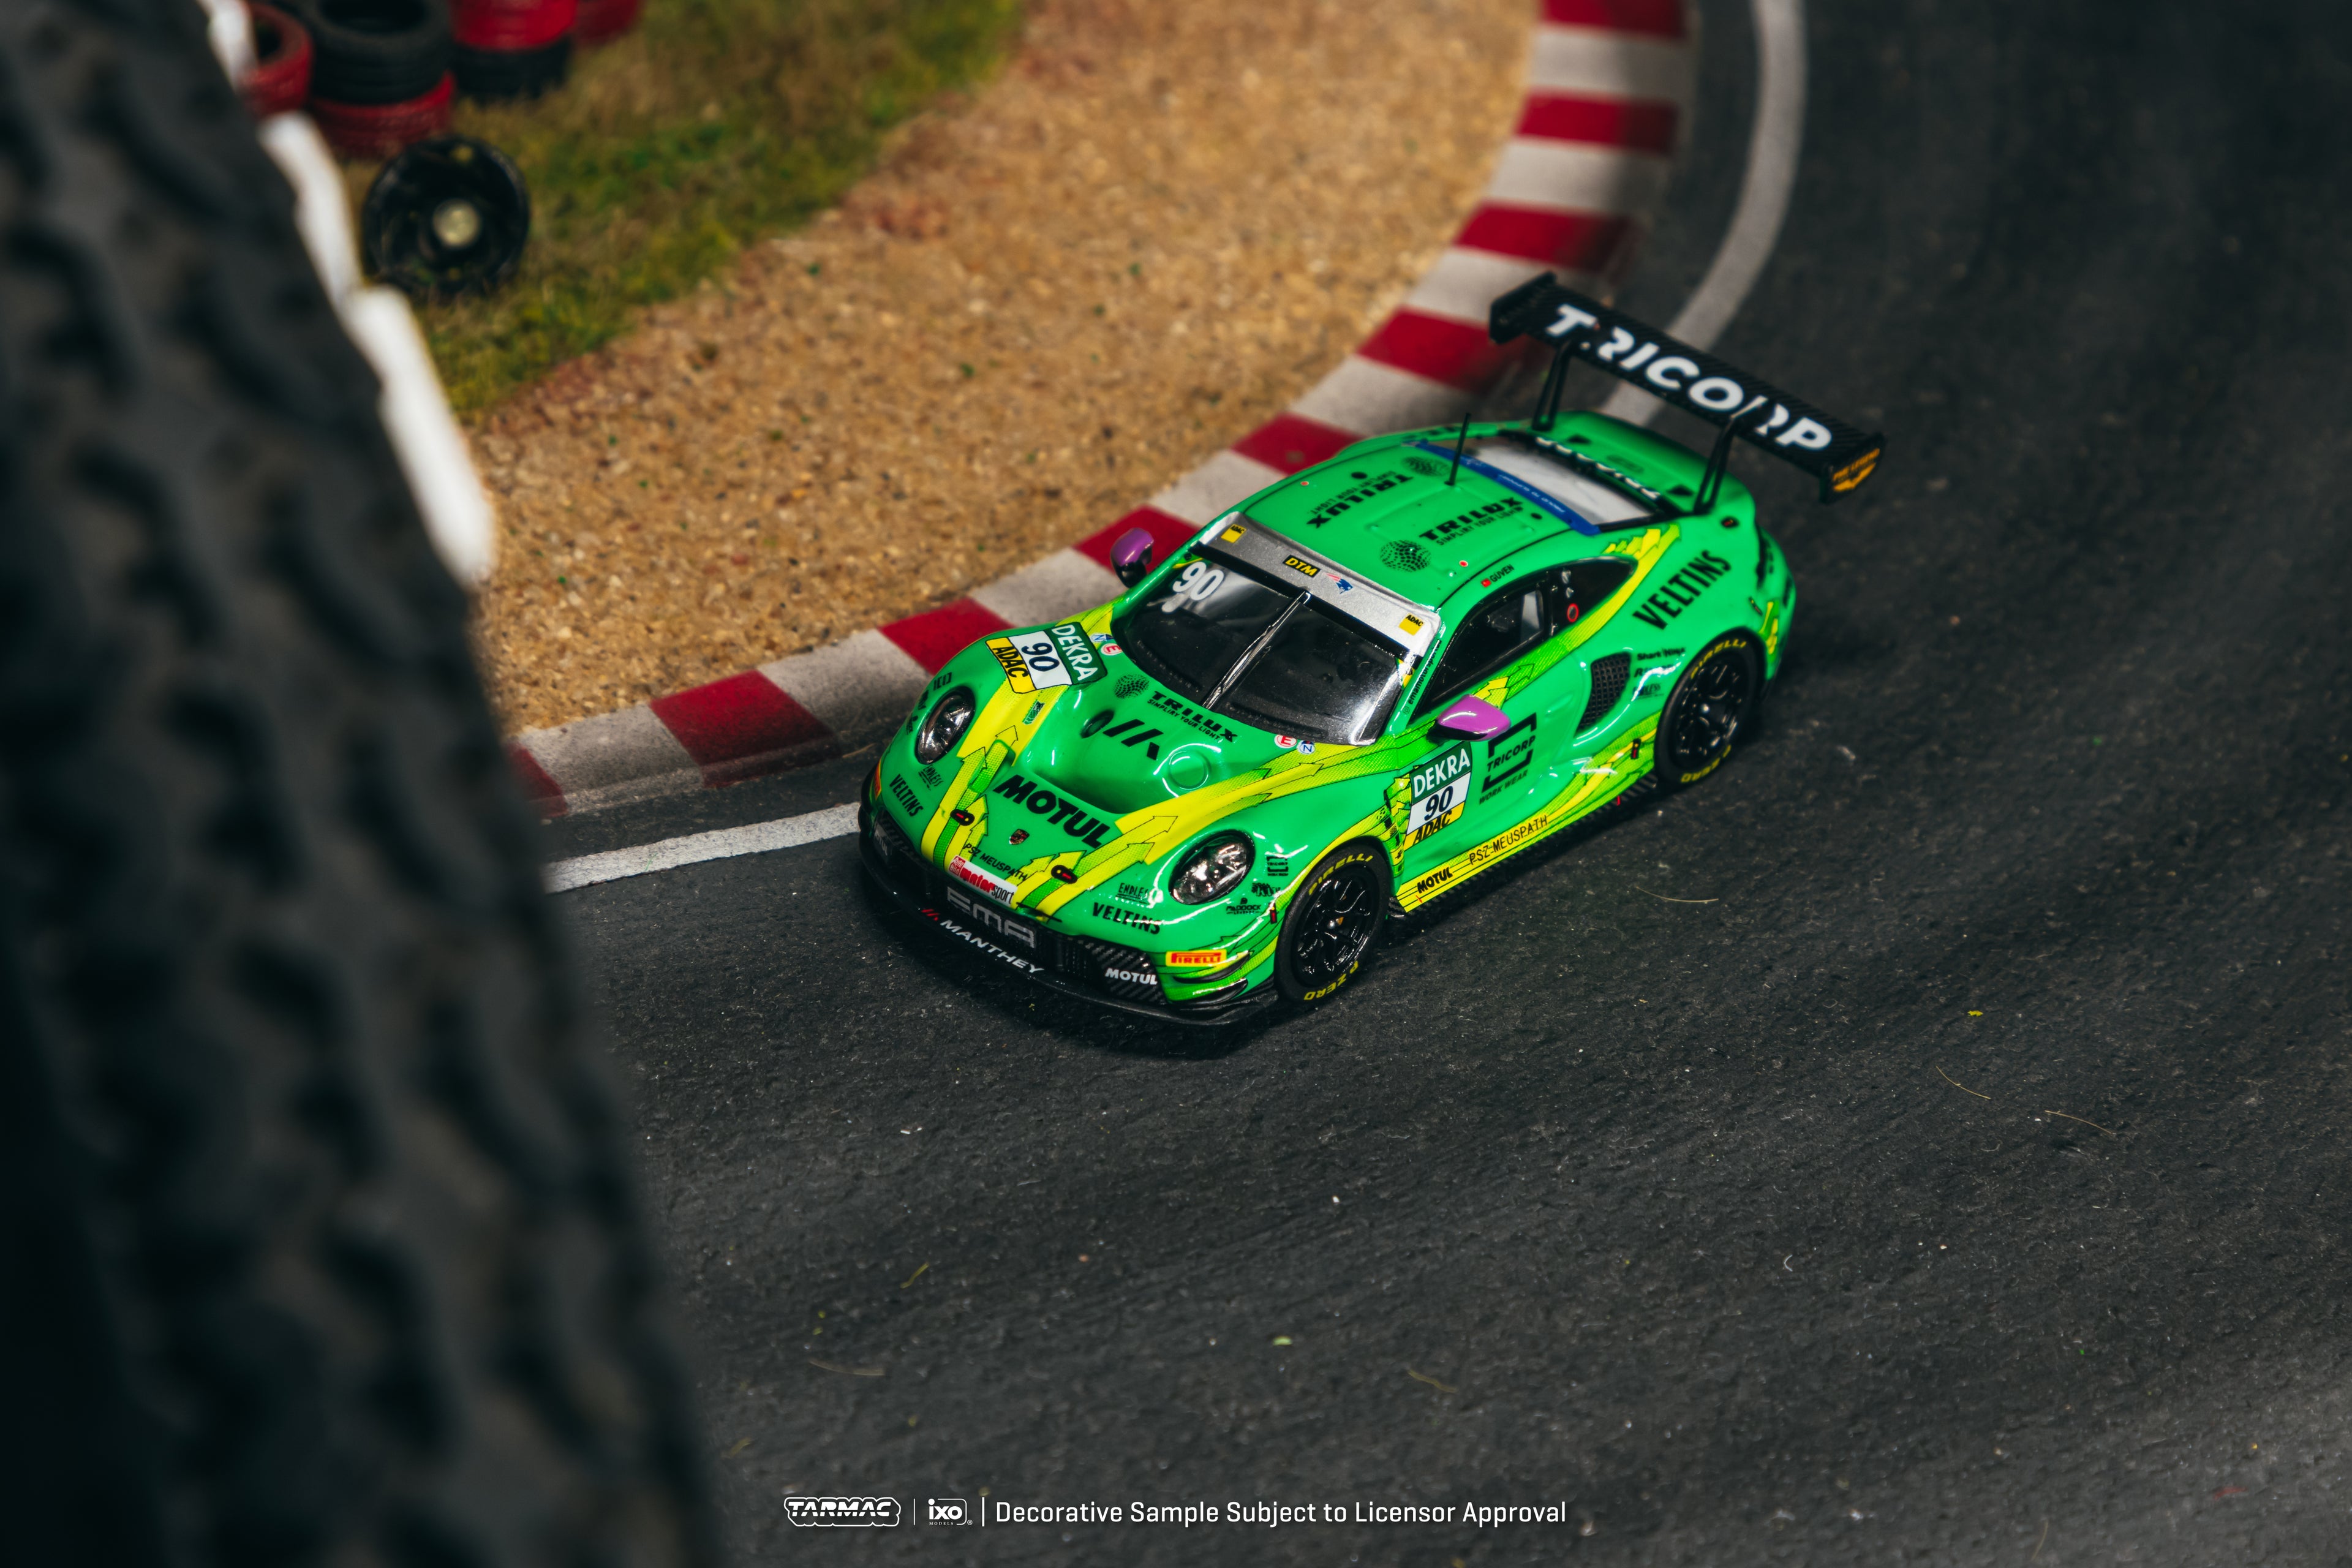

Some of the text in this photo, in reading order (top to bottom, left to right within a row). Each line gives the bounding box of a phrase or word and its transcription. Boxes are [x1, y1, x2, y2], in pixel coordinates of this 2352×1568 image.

[1546, 304, 1832, 451] TRICORP
[1306, 474, 1414, 529] TRILUX
[1419, 497, 1523, 540] TRILUX
[1474, 516, 1496, 527] YOUR
[1172, 561, 1224, 601] 90
[1286, 557, 1319, 576] DTM
[1632, 550, 1732, 631] VELTINS
[1405, 614, 1423, 627] ADAC
[993, 645, 1028, 679] ADAC
[1022, 642, 1060, 671] 90
[1052, 625, 1099, 682] DEKRA
[1691, 639, 1747, 679] PIRELLI
[1152, 690, 1238, 742] TRILUX
[1180, 715, 1199, 728] YOUR
[1487, 735, 1536, 772] TRICORP
[1413, 748, 1471, 798] DEKRA
[1479, 769, 1528, 805] WORK WEAR
[889, 774, 924, 817] VELTINS
[993, 774, 1110, 849] MOTUL
[1424, 786, 1453, 821] 90
[1412, 809, 1452, 846] ADAC
[962, 843, 1028, 881] PSZ MEUSPATH
[1308, 853, 1373, 896] PIRELLI
[1417, 867, 1453, 894] MOTUL
[1118, 882, 1154, 899] ENDLES
[1093, 902, 1161, 935] VELTINS
[940, 919, 1045, 974] MANTHEY
[1171, 952, 1222, 964] PIRELLI
[1105, 968, 1158, 986] MOTUL
[1303, 973, 1347, 1001] ZERO
